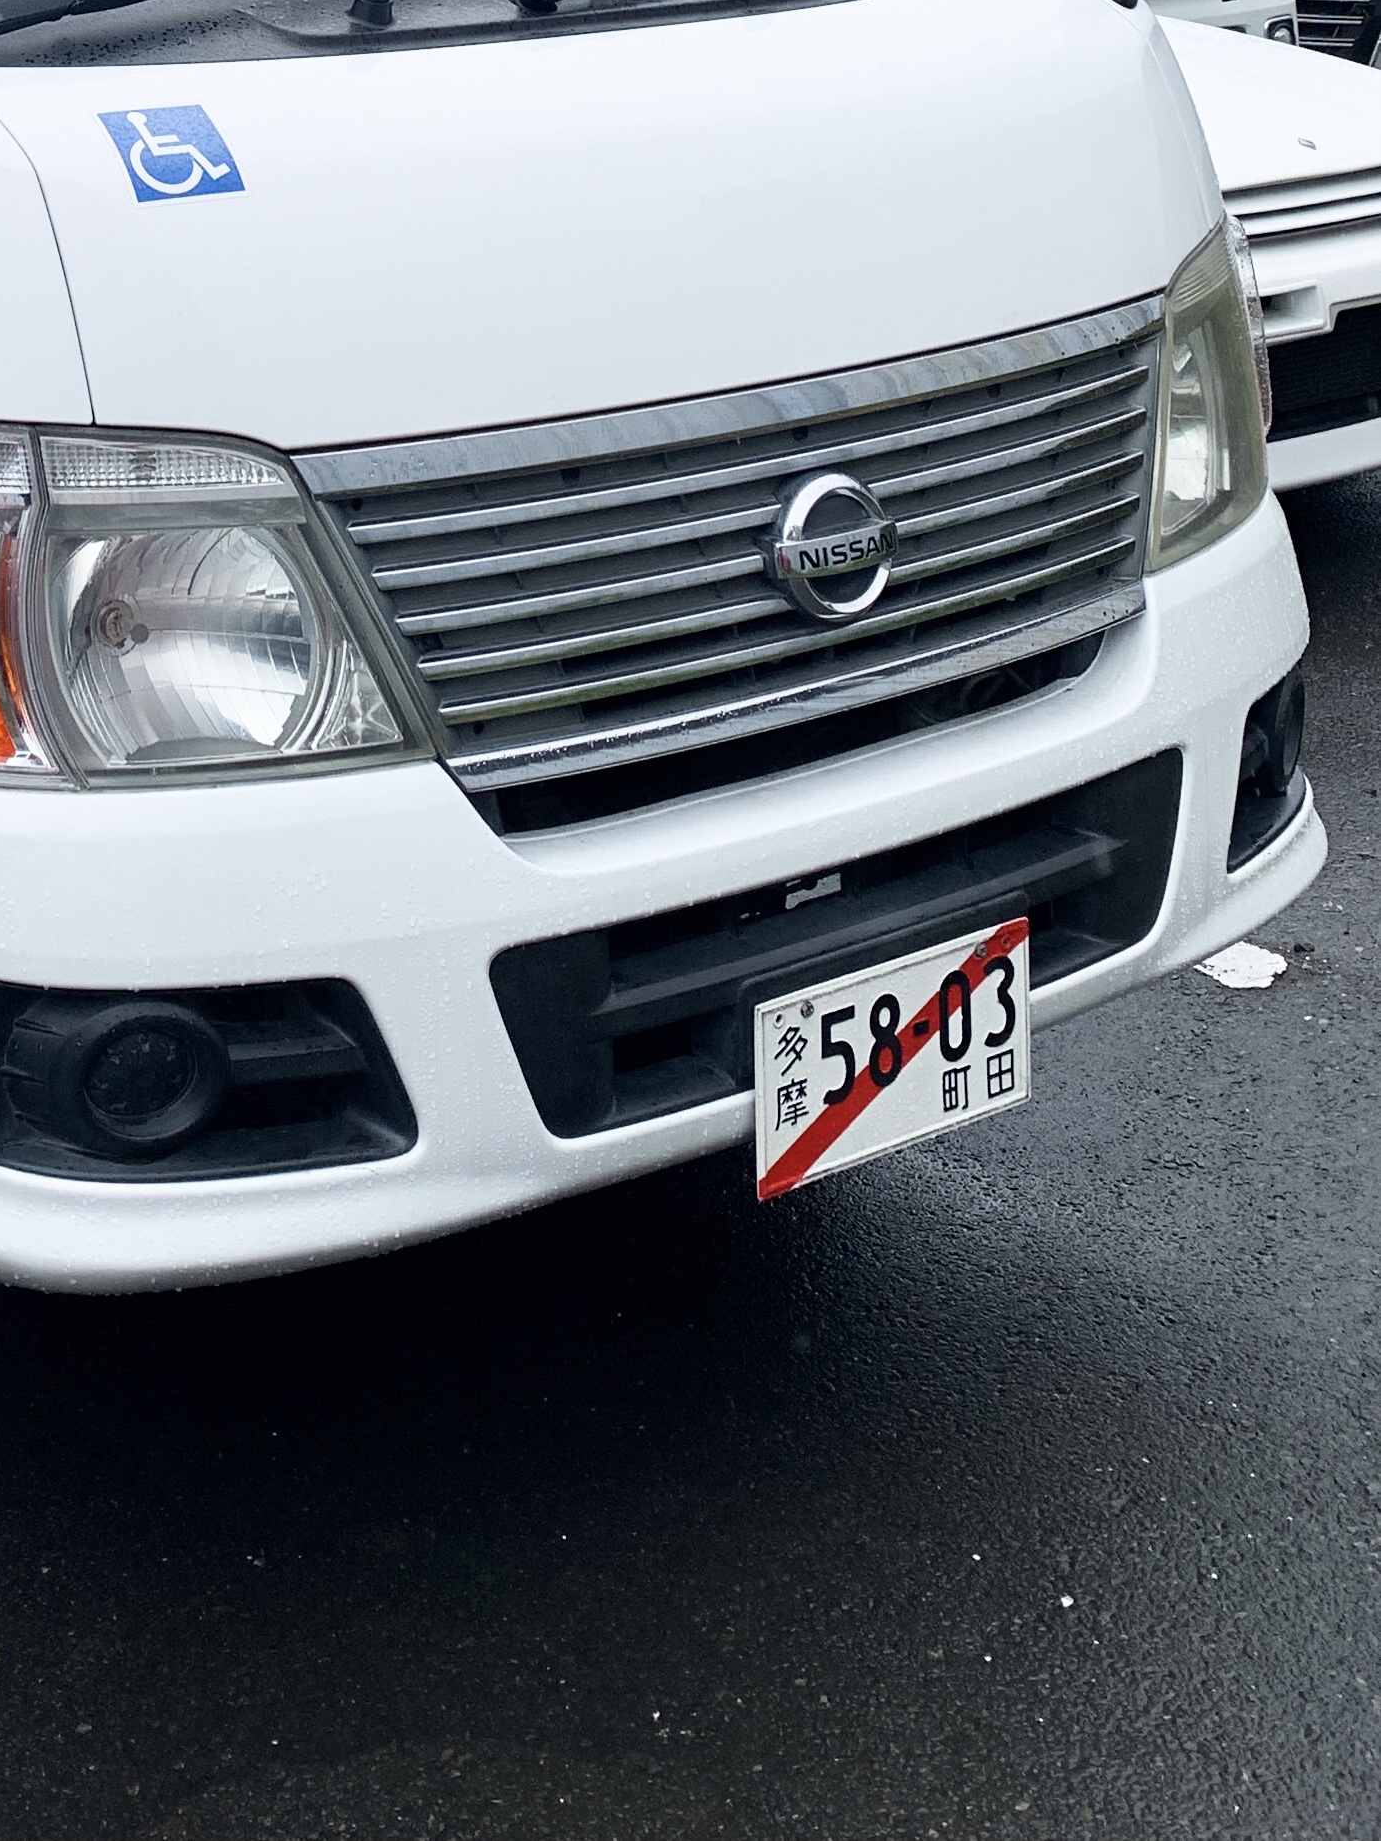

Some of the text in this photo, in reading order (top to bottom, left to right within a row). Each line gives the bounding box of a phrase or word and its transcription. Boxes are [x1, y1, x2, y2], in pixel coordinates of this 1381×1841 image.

[799, 532, 894, 570] NISSAN
[821, 956, 1016, 1105] 58-03
[774, 1026, 809, 1131] 多摩
[942, 1049, 1014, 1112] 町田
